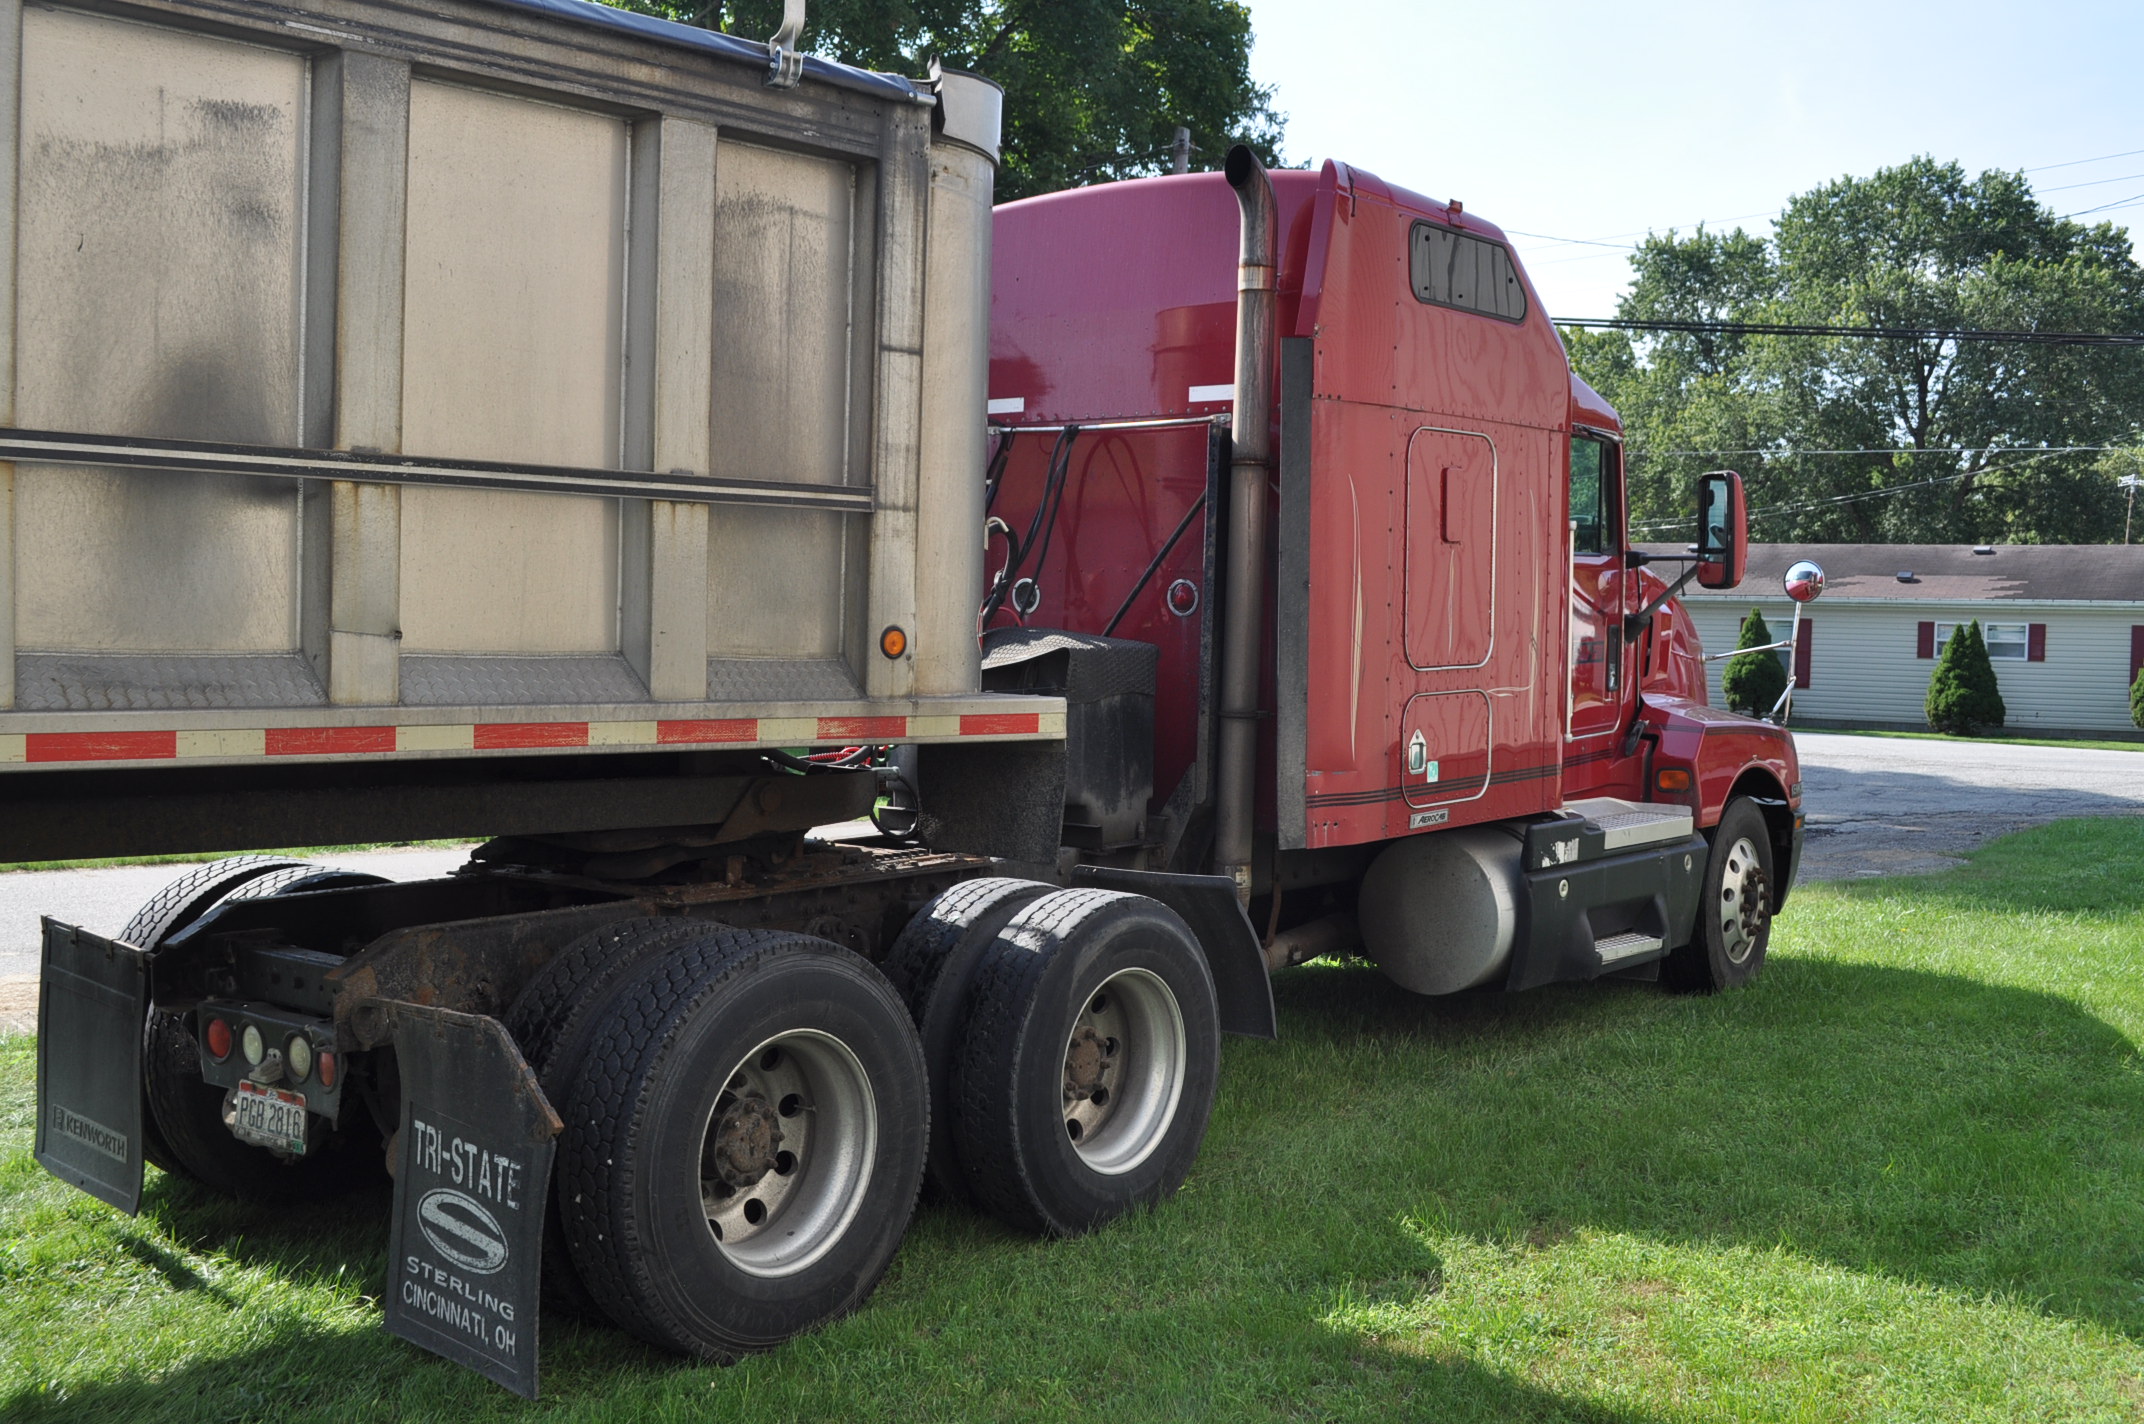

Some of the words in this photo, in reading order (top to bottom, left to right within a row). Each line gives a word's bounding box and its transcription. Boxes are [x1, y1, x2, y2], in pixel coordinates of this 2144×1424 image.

[66, 1113, 125, 1158] KENWORTH
[239, 1096, 265, 1129] PGB
[267, 1103, 301, 1139] 2816
[414, 1119, 521, 1210] TRI-STATE
[403, 1280, 489, 1346] CINCINNATI,
[495, 1325, 516, 1356] OH
[406, 1256, 514, 1322] STERLING
